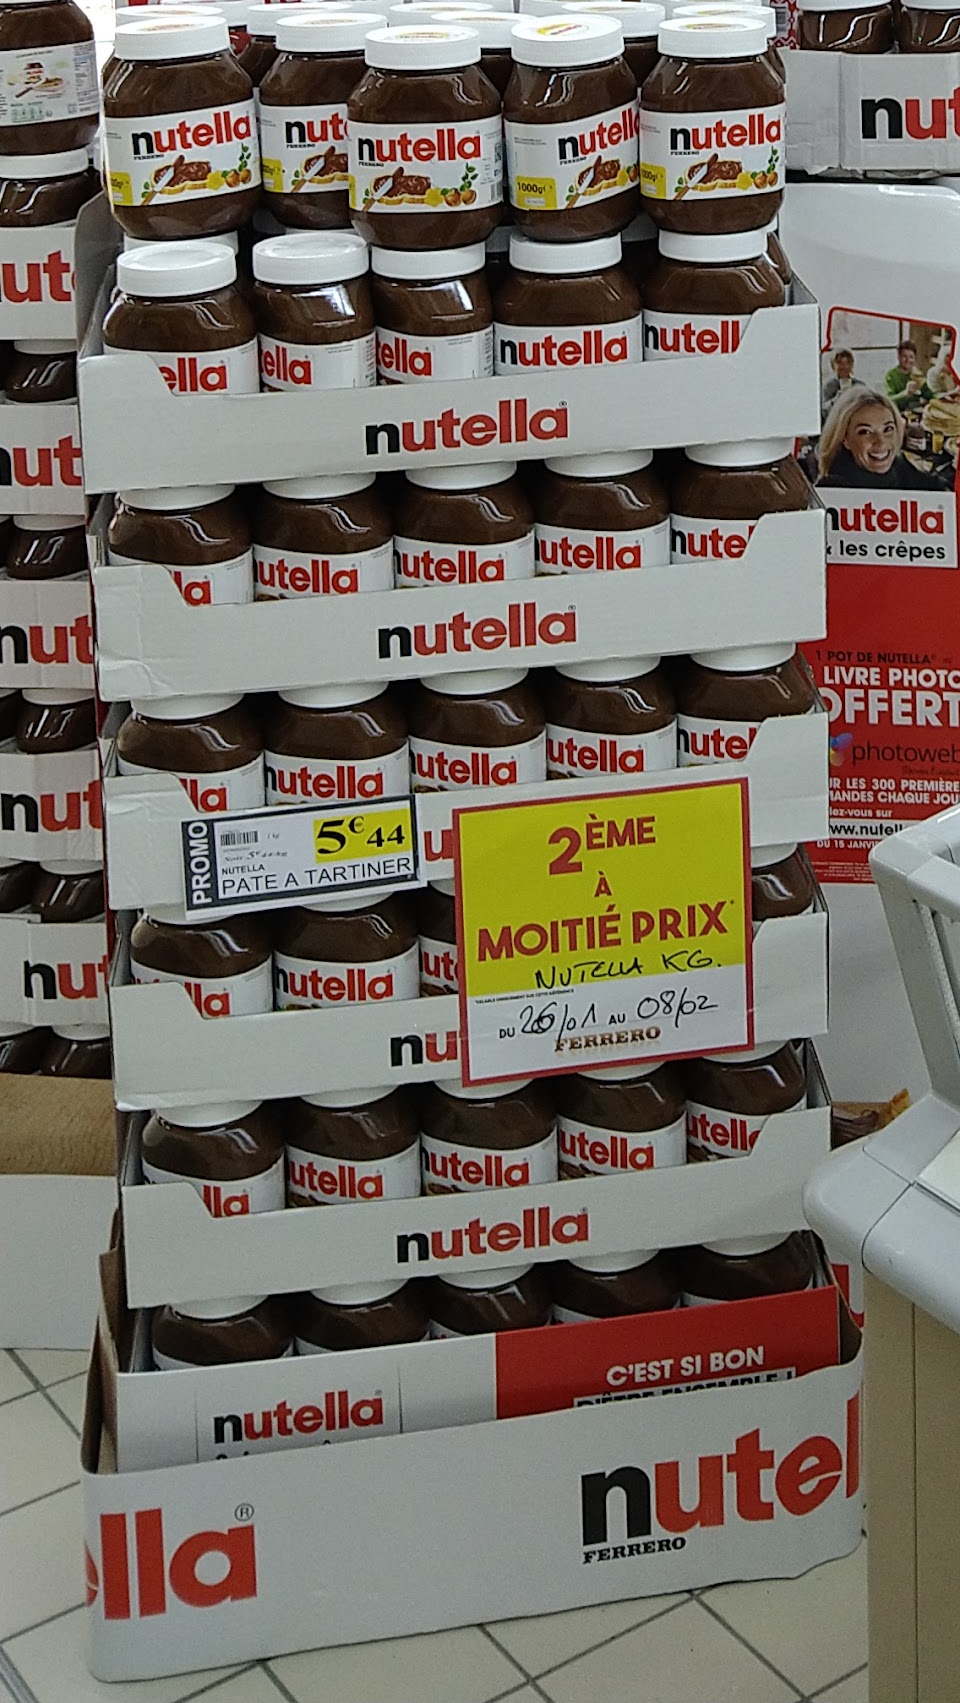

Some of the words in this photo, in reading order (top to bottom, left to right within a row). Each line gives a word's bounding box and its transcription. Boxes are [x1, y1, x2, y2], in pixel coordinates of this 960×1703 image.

[132, 111, 252, 155] nutella
[358, 129, 481, 162] nutella
[670, 113, 782, 151] nutella
[500, 330, 628, 366] nutella
[365, 398, 569, 456] nutella
[826, 500, 944, 534] nutella
[840, 540, 868, 556] les
[875, 540, 946, 563] crêpes
[378, 602, 577, 658] nutella
[827, 651, 853, 663] POT
[857, 652, 873, 663] DE
[823, 666, 881, 686] LIVRE
[846, 778, 866, 790] LES
[872, 779, 896, 791] 300
[878, 792, 931, 805] CHAQUE
[876, 809, 893, 818] sur
[548, 814, 657, 876] 2ÈME
[817, 840, 830, 849] DU
[834, 841, 845, 849] 15
[188, 821, 213, 905] PROMO
[221, 863, 266, 876] NUTELLA
[222, 874, 278, 896] PATE
[284, 873, 299, 888] A
[304, 857, 412, 885] TARTINER
[594, 871, 612, 898] À
[477, 905, 621, 963] MOITIÉ
[608, 1013, 626, 1025] AU
[637, 987, 719, 1028] 08/02
[499, 1027, 515, 1039] DU
[554, 1026, 662, 1053] FERRERO
[397, 1207, 590, 1263] nutella
[606, 1358, 675, 1386] C'EST
[680, 1355, 701, 1376] SI
[709, 1345, 764, 1371] BON
[214, 1390, 384, 1445] nutella
[582, 1536, 687, 1564] FERRERO
